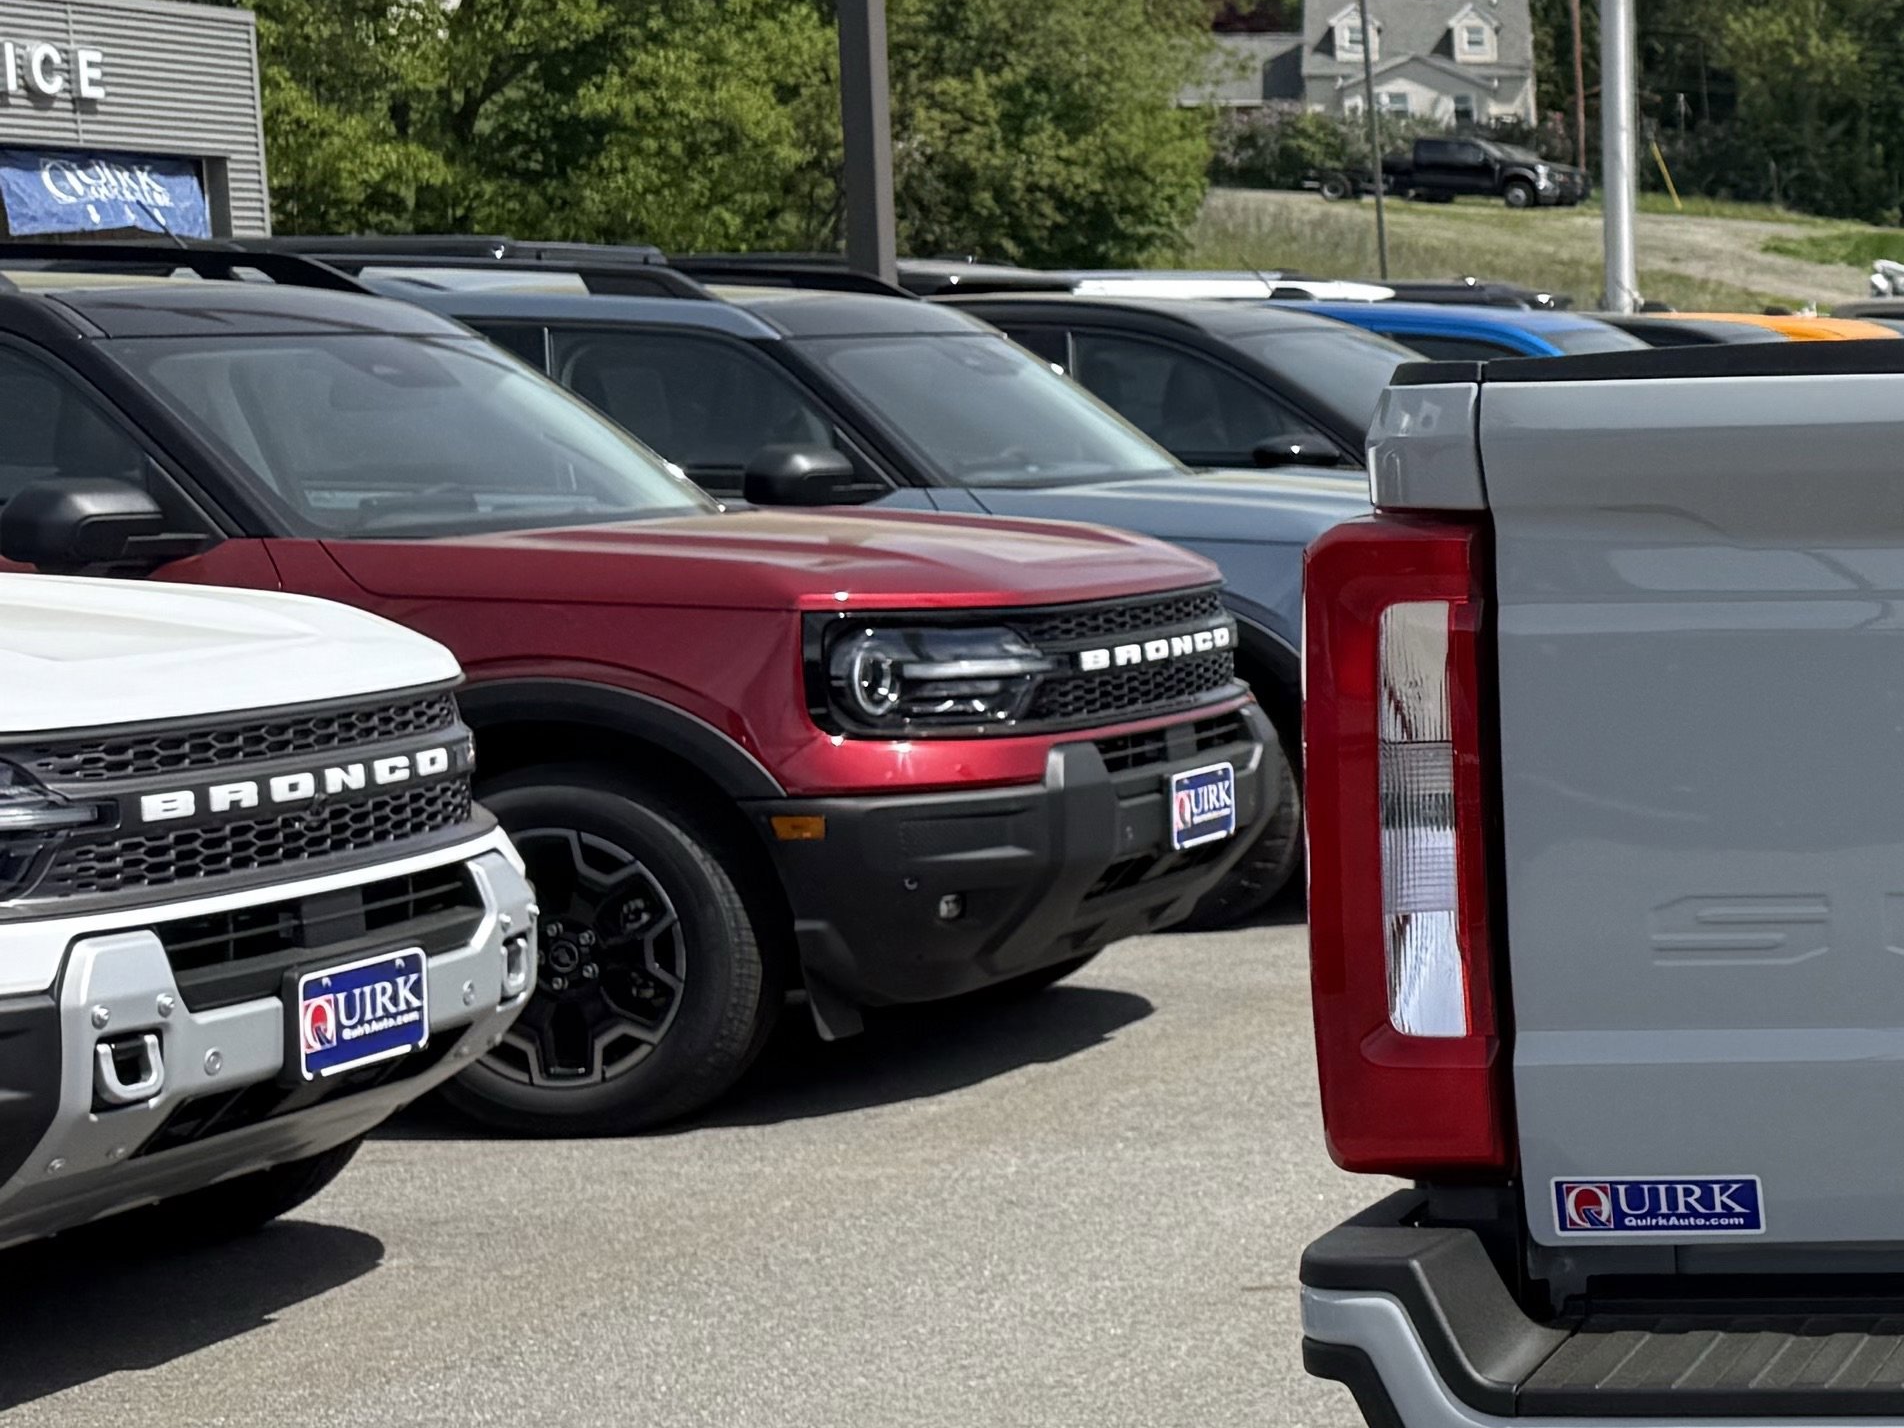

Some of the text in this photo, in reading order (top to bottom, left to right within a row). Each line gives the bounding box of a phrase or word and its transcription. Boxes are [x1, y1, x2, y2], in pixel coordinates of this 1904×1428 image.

[1080, 627, 1230, 671] BRONCO
[141, 747, 448, 822] BRONCO
[1176, 780, 1232, 830] QUIRK
[304, 973, 423, 1051] QUIRK
[1565, 1183, 1750, 1229] QUIRK
[1624, 1215, 1744, 1227] QuirkAuto.com
